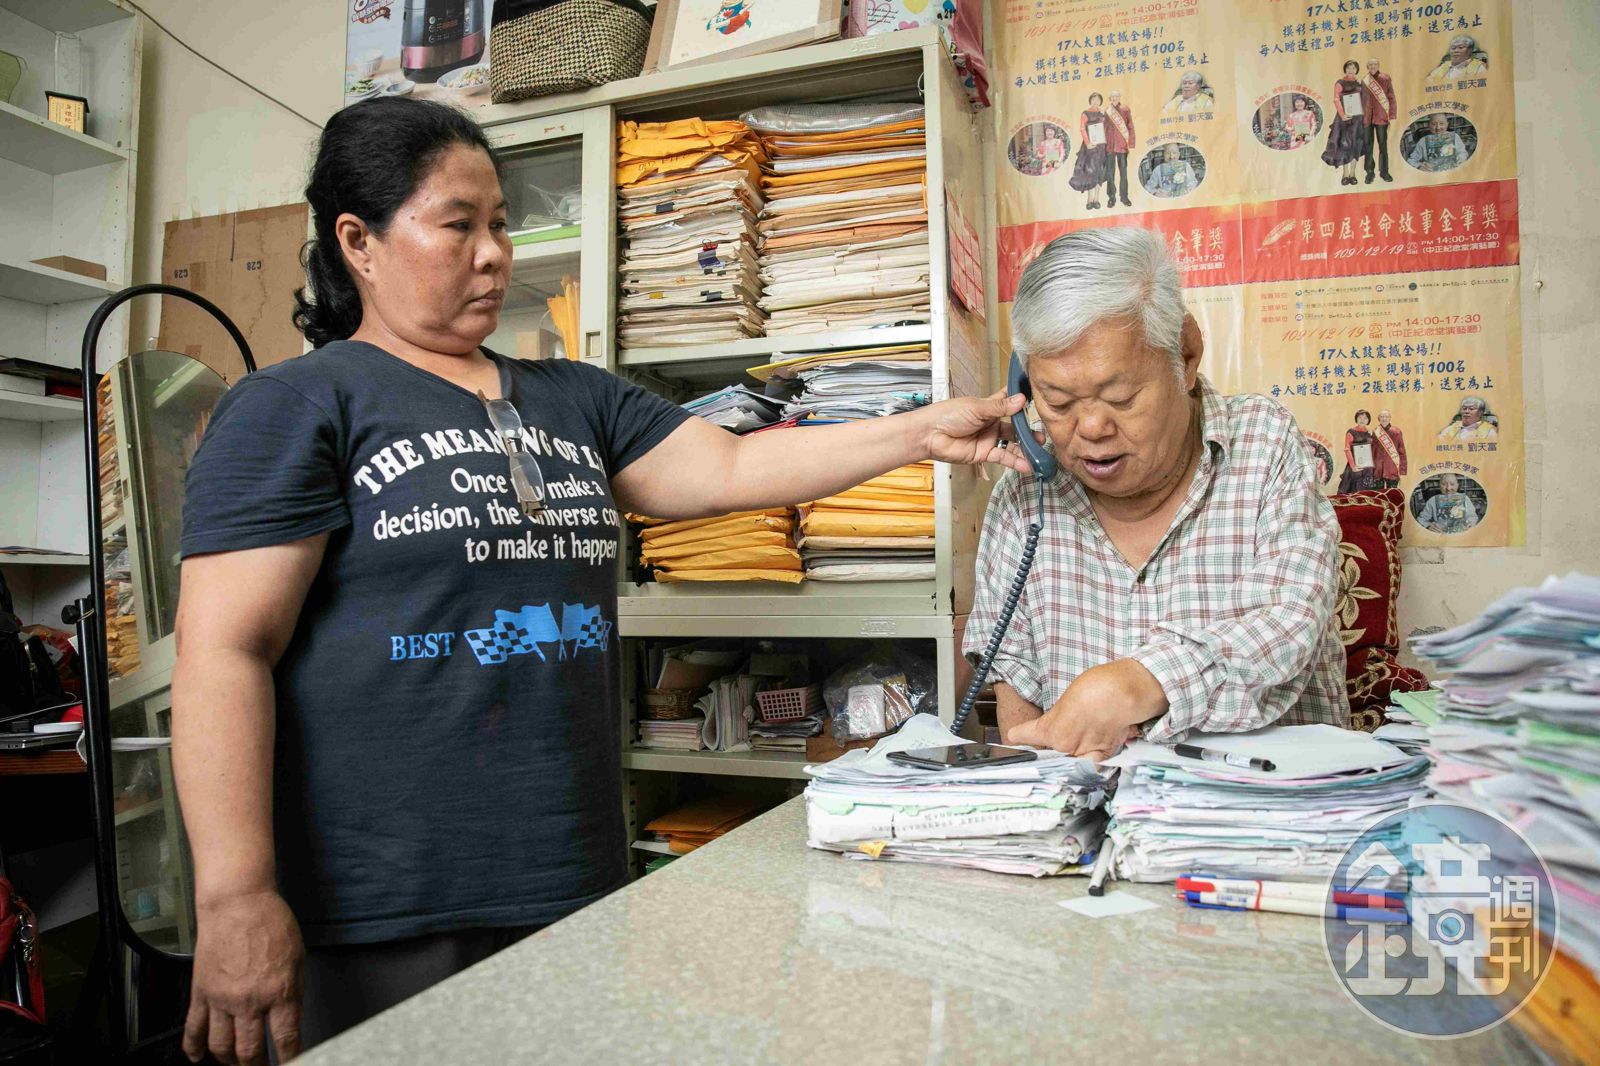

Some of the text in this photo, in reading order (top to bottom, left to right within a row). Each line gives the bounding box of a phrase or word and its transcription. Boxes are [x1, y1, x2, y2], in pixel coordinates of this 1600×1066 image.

[1334, 244, 1404, 259] 109/12/19
[1436, 233, 1499, 243] 14:00-17:30
[1405, 313, 1481, 326] 14:00-17:30
[1281, 327, 1366, 342] 109/12/19
[353, 438, 425, 495] THE
[553, 438, 580, 464] OF
[450, 468, 508, 493] Once
[546, 473, 594, 499] make
[592, 480, 605, 496] a
[373, 502, 480, 540] decision,
[487, 499, 522, 525] the
[465, 531, 617, 565] to make it happen
[390, 632, 456, 660] BEST
